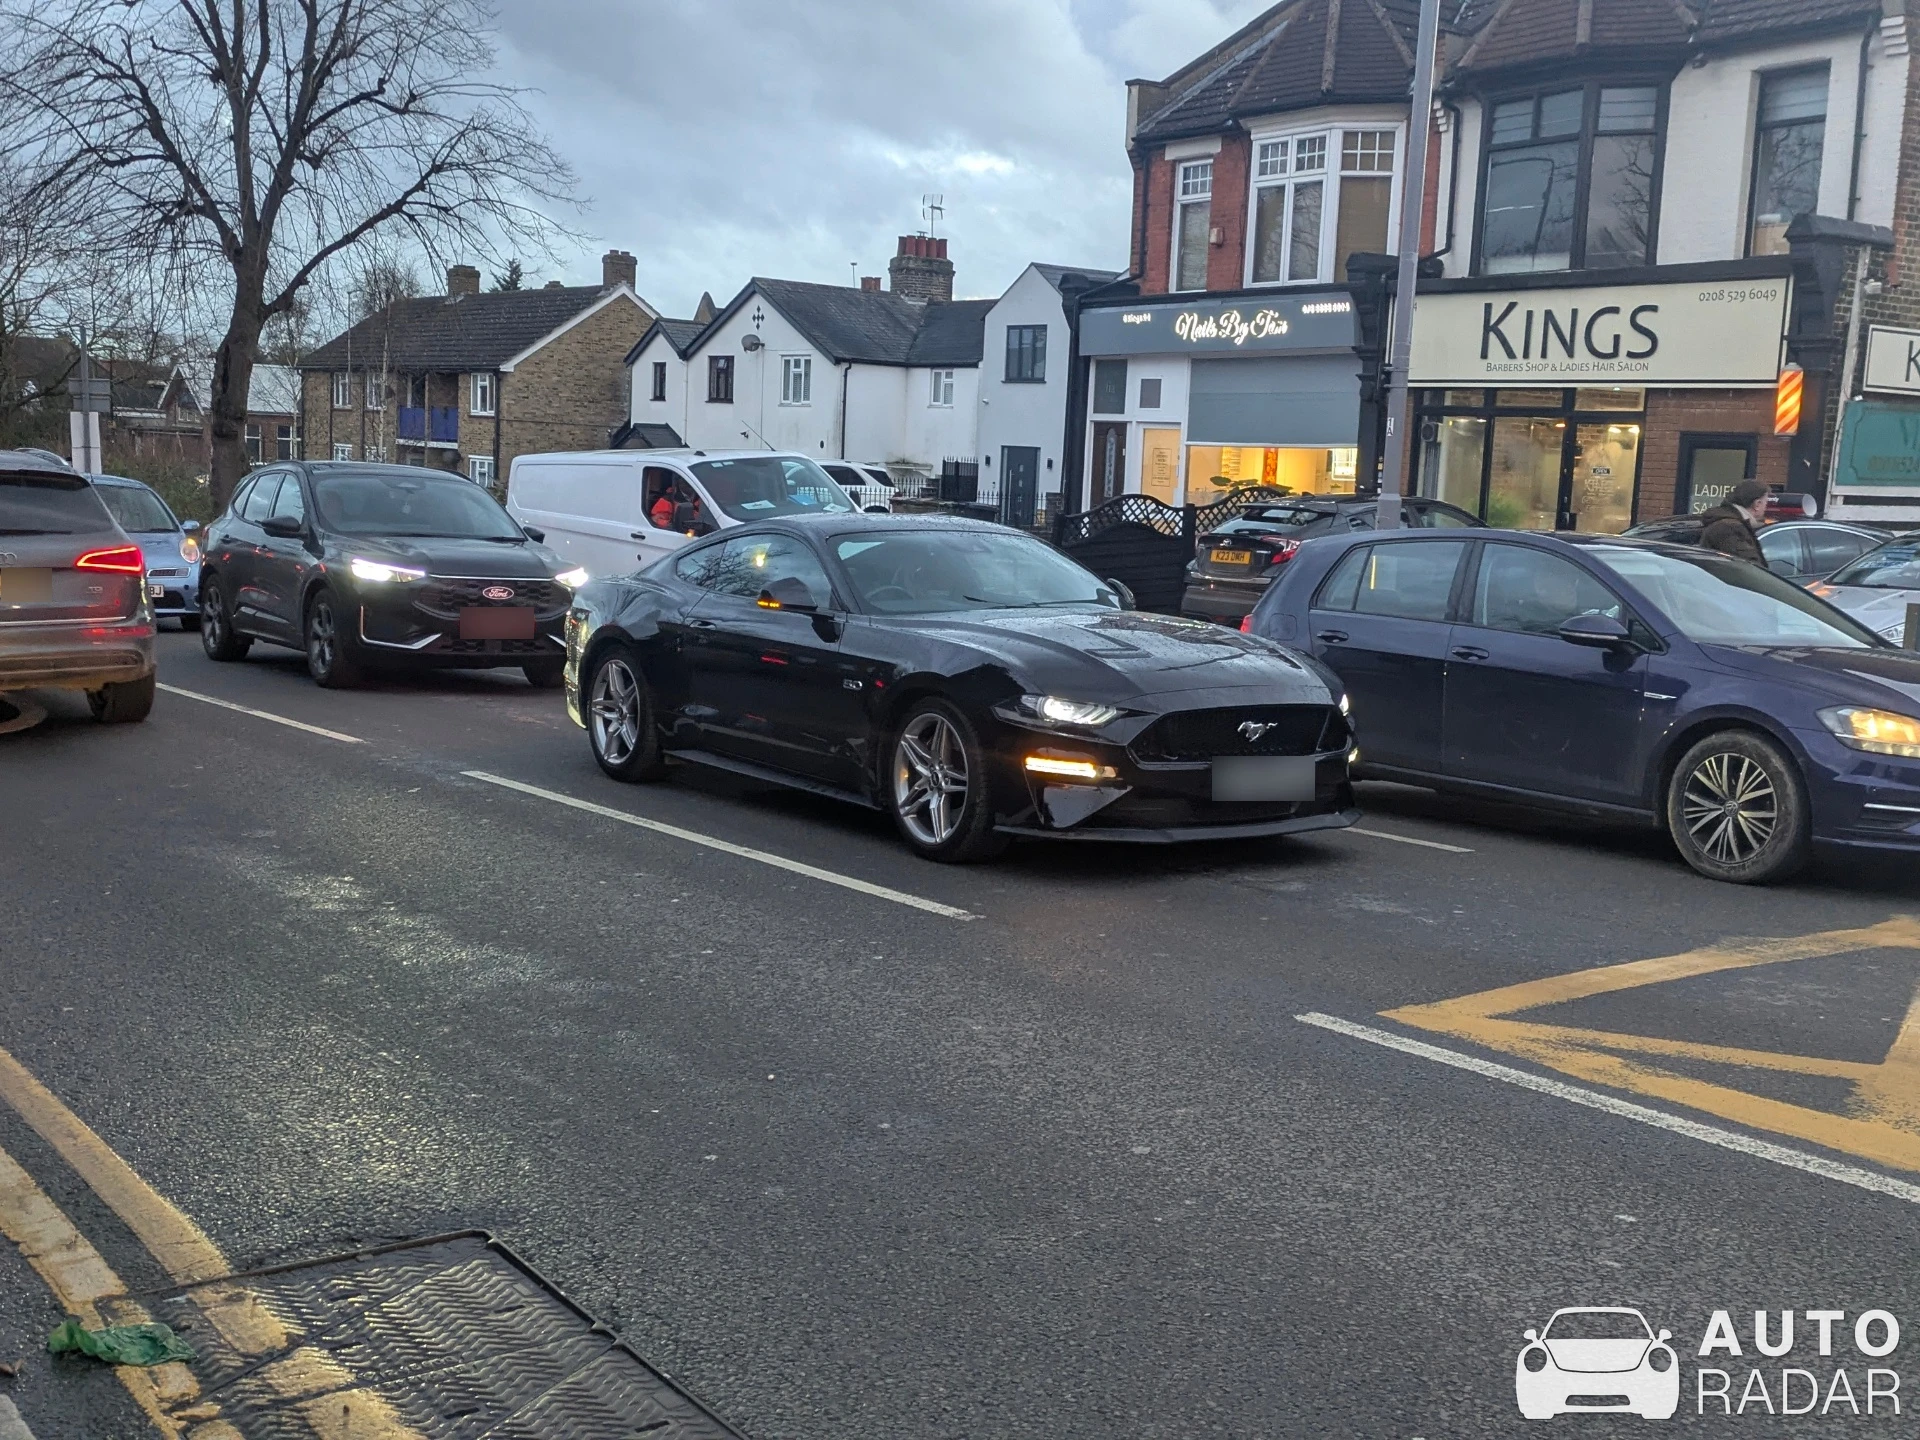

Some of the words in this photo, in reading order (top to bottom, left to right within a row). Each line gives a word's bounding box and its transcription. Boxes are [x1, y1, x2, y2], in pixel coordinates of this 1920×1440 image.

[1699, 289, 1725, 302] 0208
[1727, 290, 1746, 303] 529
[1749, 288, 1777, 302] 6049
[1175, 312, 1218, 342] Nails
[1218, 309, 1249, 345] By
[1480, 301, 1659, 360] KINGS
[1486, 362, 1523, 372] BARBERS
[1525, 362, 1549, 372] SHOP
[1550, 363, 1558, 372] &
[1559, 361, 1590, 372] LADIES
[1592, 361, 1615, 372] HAIR
[1617, 361, 1649, 372] SALON
